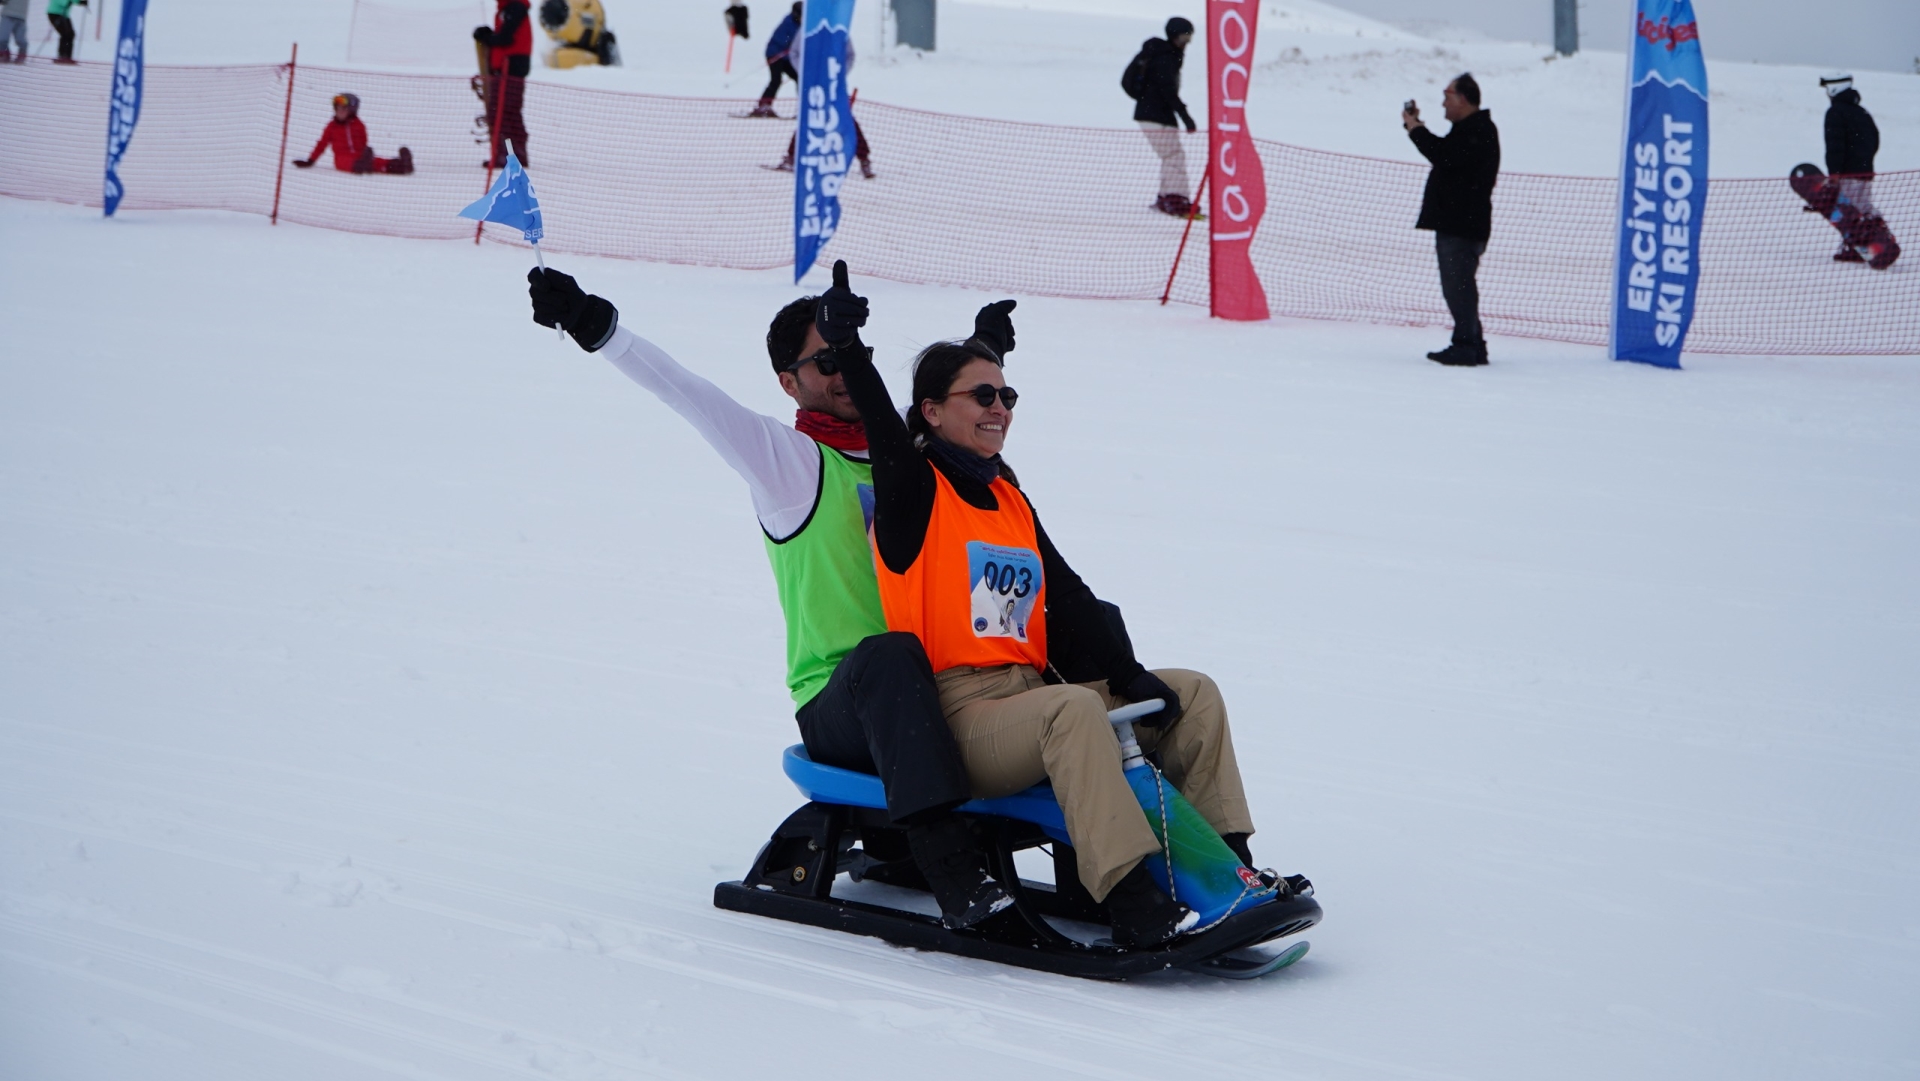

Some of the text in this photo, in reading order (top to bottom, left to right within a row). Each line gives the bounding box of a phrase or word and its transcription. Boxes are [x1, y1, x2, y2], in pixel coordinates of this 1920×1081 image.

[1626, 142, 1659, 312] ERCİYES
[1655, 113, 1694, 348] SKI RESORT
[983, 561, 1032, 598] 003
